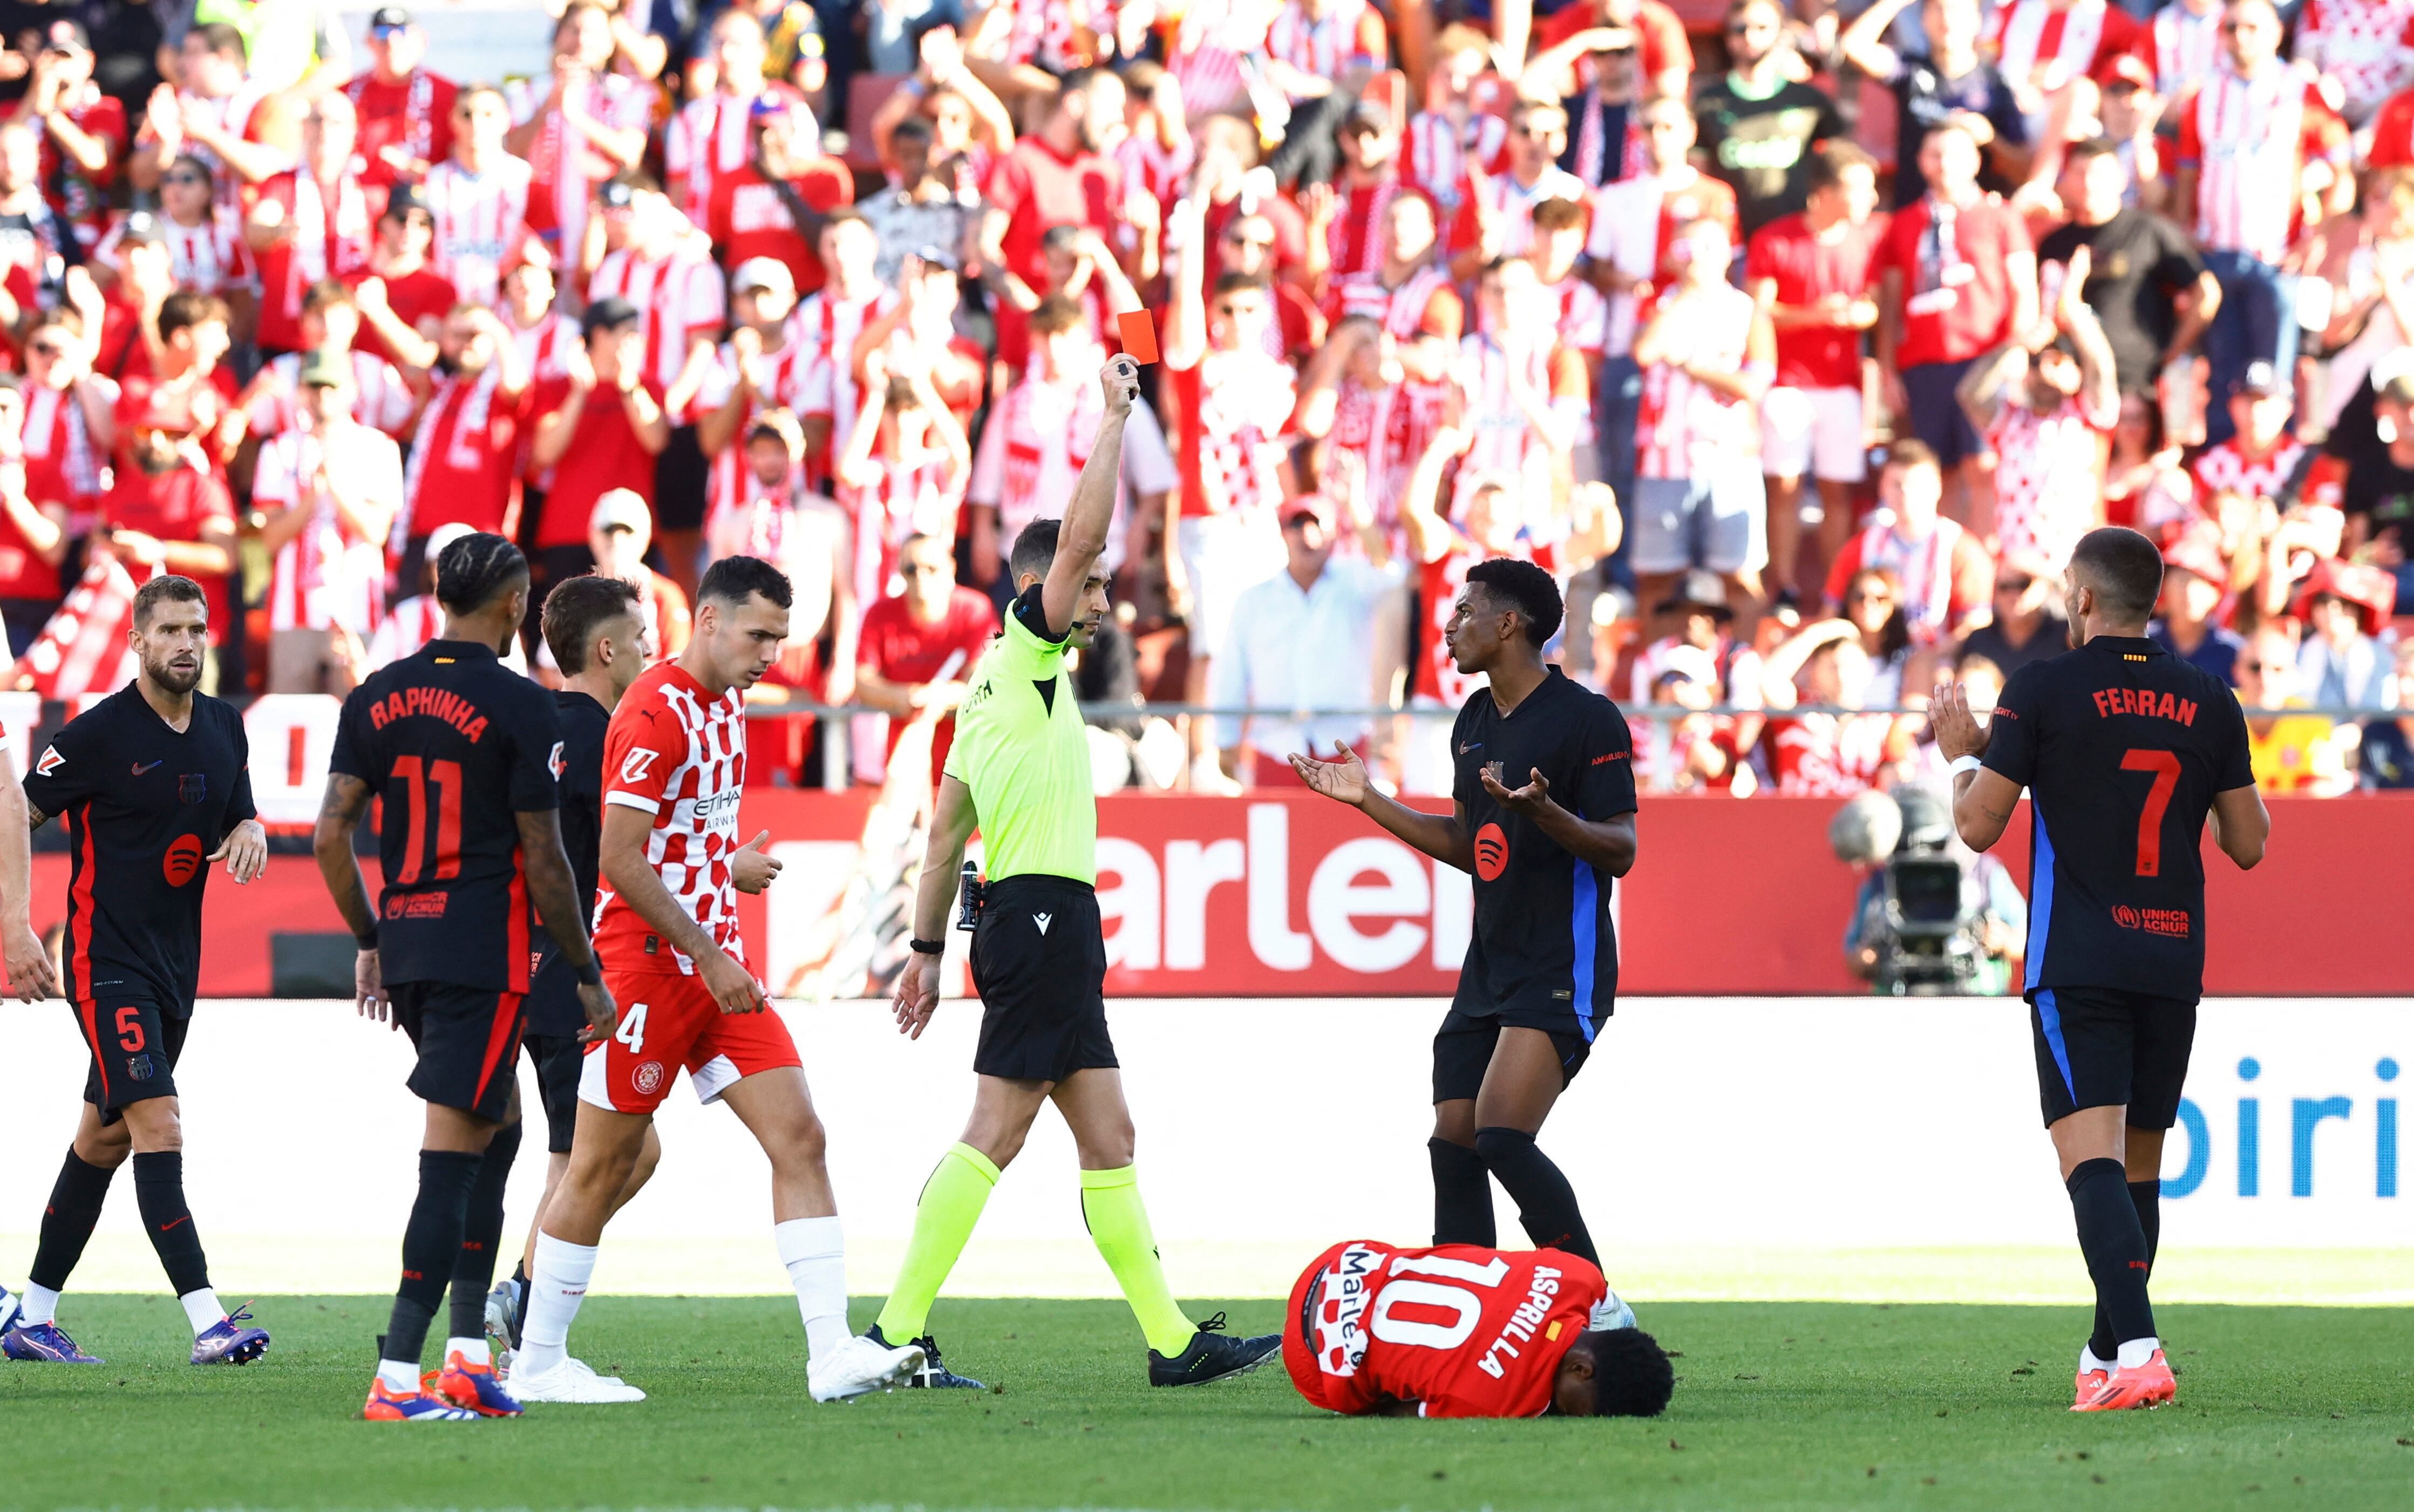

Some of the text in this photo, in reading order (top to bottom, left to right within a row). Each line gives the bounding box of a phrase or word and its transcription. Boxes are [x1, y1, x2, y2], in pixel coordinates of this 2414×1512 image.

[370, 687, 488, 743] RAPHINHA
[2093, 689, 2197, 726] FERRAN
[391, 756, 461, 884] 11
[2121, 750, 2181, 876] 7
[2141, 909, 2188, 922] UNHCR
[2144, 920, 2188, 933] ACNUR
[115, 1007, 145, 1052] 5
[616, 1004, 647, 1053] 4
[1370, 1255, 1511, 1350] 10
[1477, 1265, 1562, 1379] ASPRILLA
